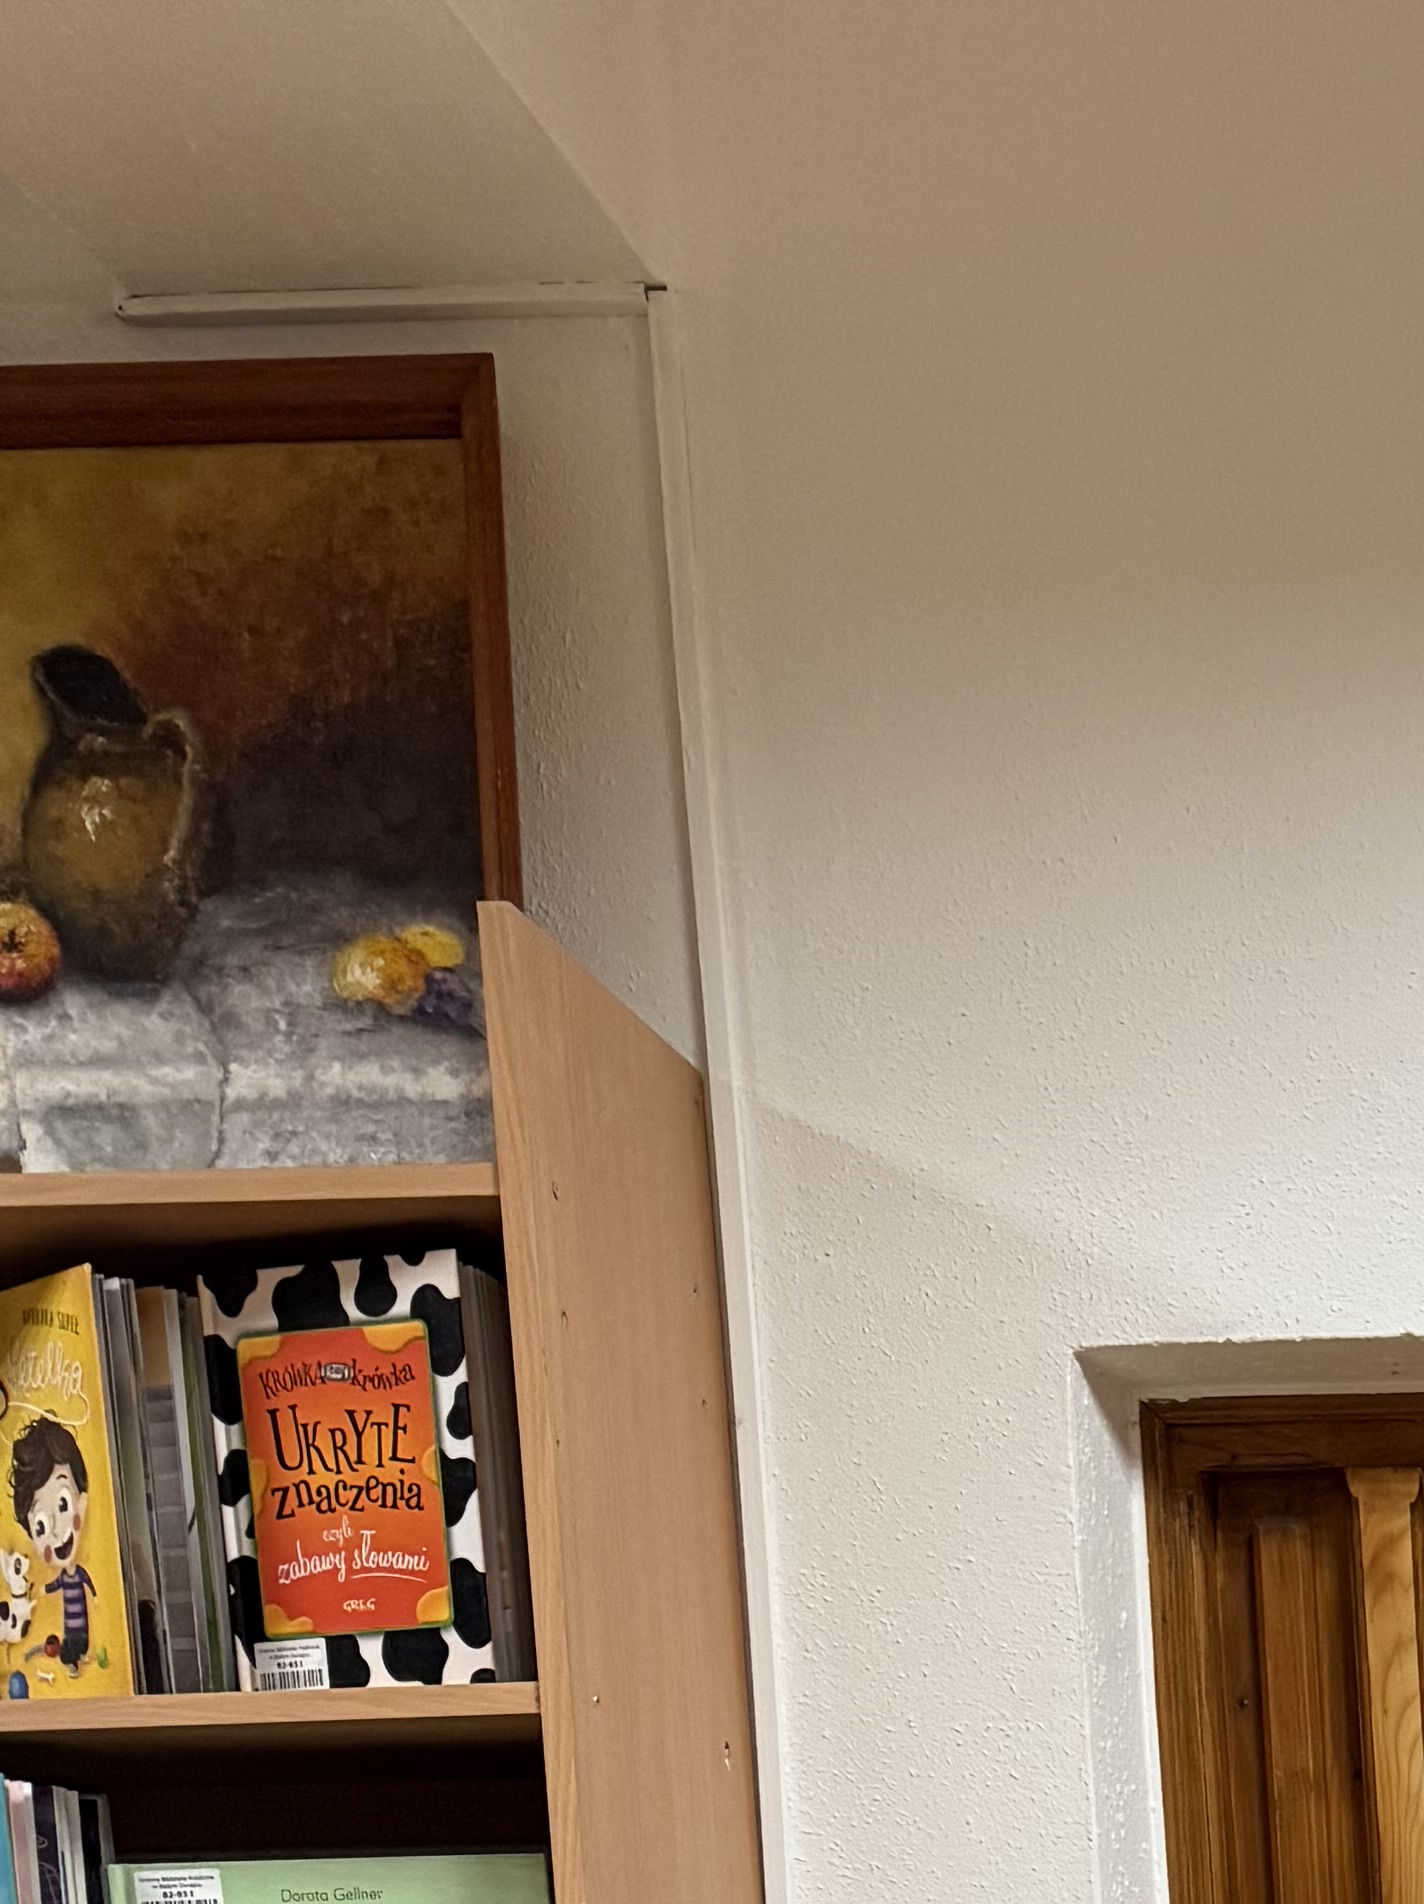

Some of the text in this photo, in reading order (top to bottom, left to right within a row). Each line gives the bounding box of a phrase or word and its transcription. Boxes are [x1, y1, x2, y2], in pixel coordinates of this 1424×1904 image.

[266, 1402, 416, 1475] UKRYTE
[271, 1469, 424, 1520] znaczenia
[323, 1515, 354, 1547] czyli
[278, 1530, 430, 1584] zabawy słowami
[281, 1887, 384, 1904] Dorota Gellner
